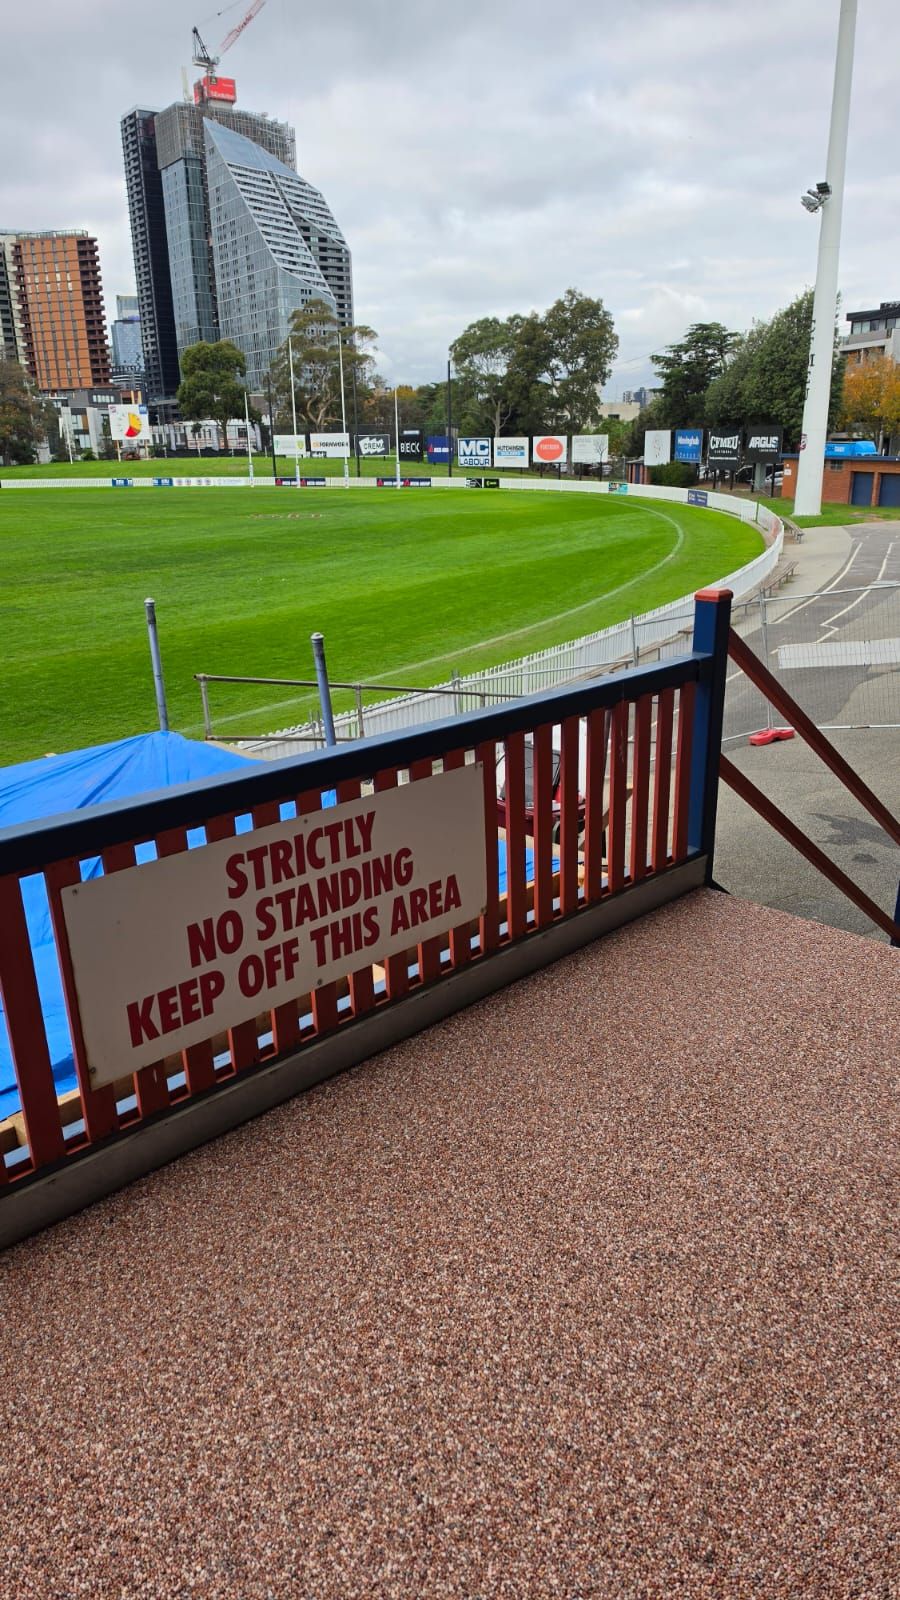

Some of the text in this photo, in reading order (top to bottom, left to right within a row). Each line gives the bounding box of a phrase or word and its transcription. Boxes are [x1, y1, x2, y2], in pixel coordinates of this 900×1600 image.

[400, 442, 420, 453] BECK
[460, 440, 489, 456] MC
[710, 435, 739, 450] CFMEU
[748, 436, 779, 448] ARGUS
[460, 458, 490, 466] LABOUR
[225, 810, 376, 899] STRICTLY
[187, 847, 414, 969] NO STANDING
[126, 874, 462, 1049] KEEP OFF THIS AREA
